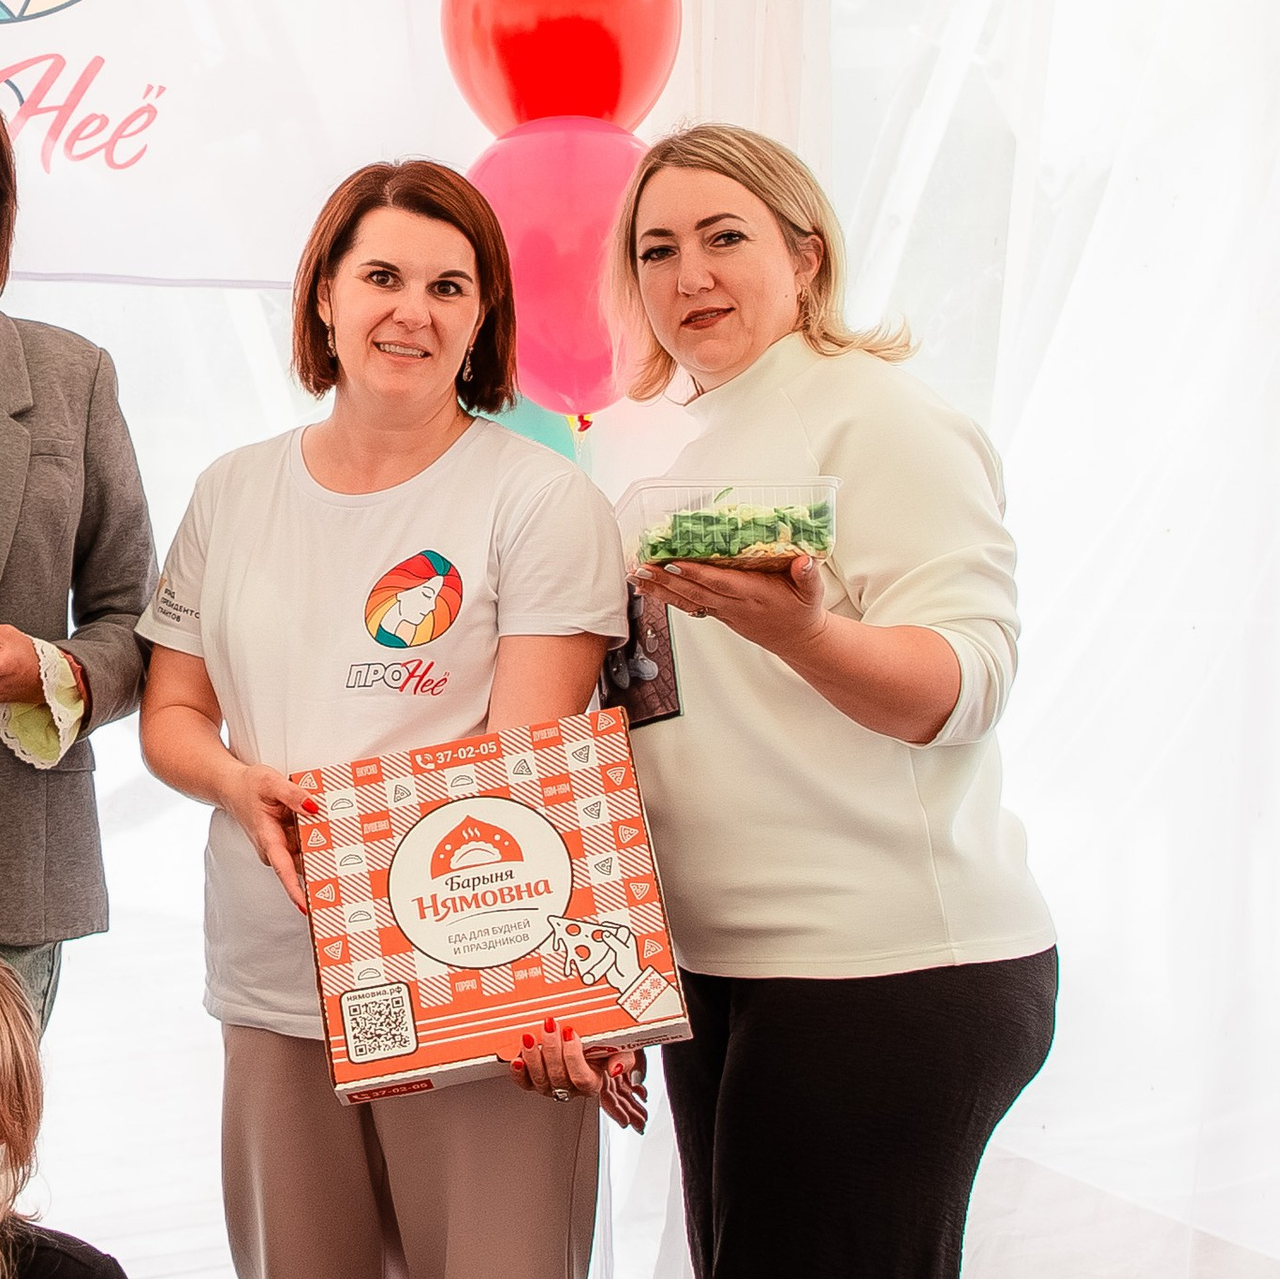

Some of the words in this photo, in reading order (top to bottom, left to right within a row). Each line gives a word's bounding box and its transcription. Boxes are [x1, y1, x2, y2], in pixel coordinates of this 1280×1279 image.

[436, 742, 497, 763] 37-02-05
[445, 870, 515, 891] Барыня
[411, 879, 554, 922] Нямовна
[448, 933, 468, 944] ЕДА
[469, 928, 490, 942] ДЛЯ
[492, 918, 531, 935] БУДНЕЙ
[453, 946, 461, 955] И
[463, 933, 530, 954] ПРАЗДНИКОВ
[372, 1083, 428, 1097] 37-02-05
